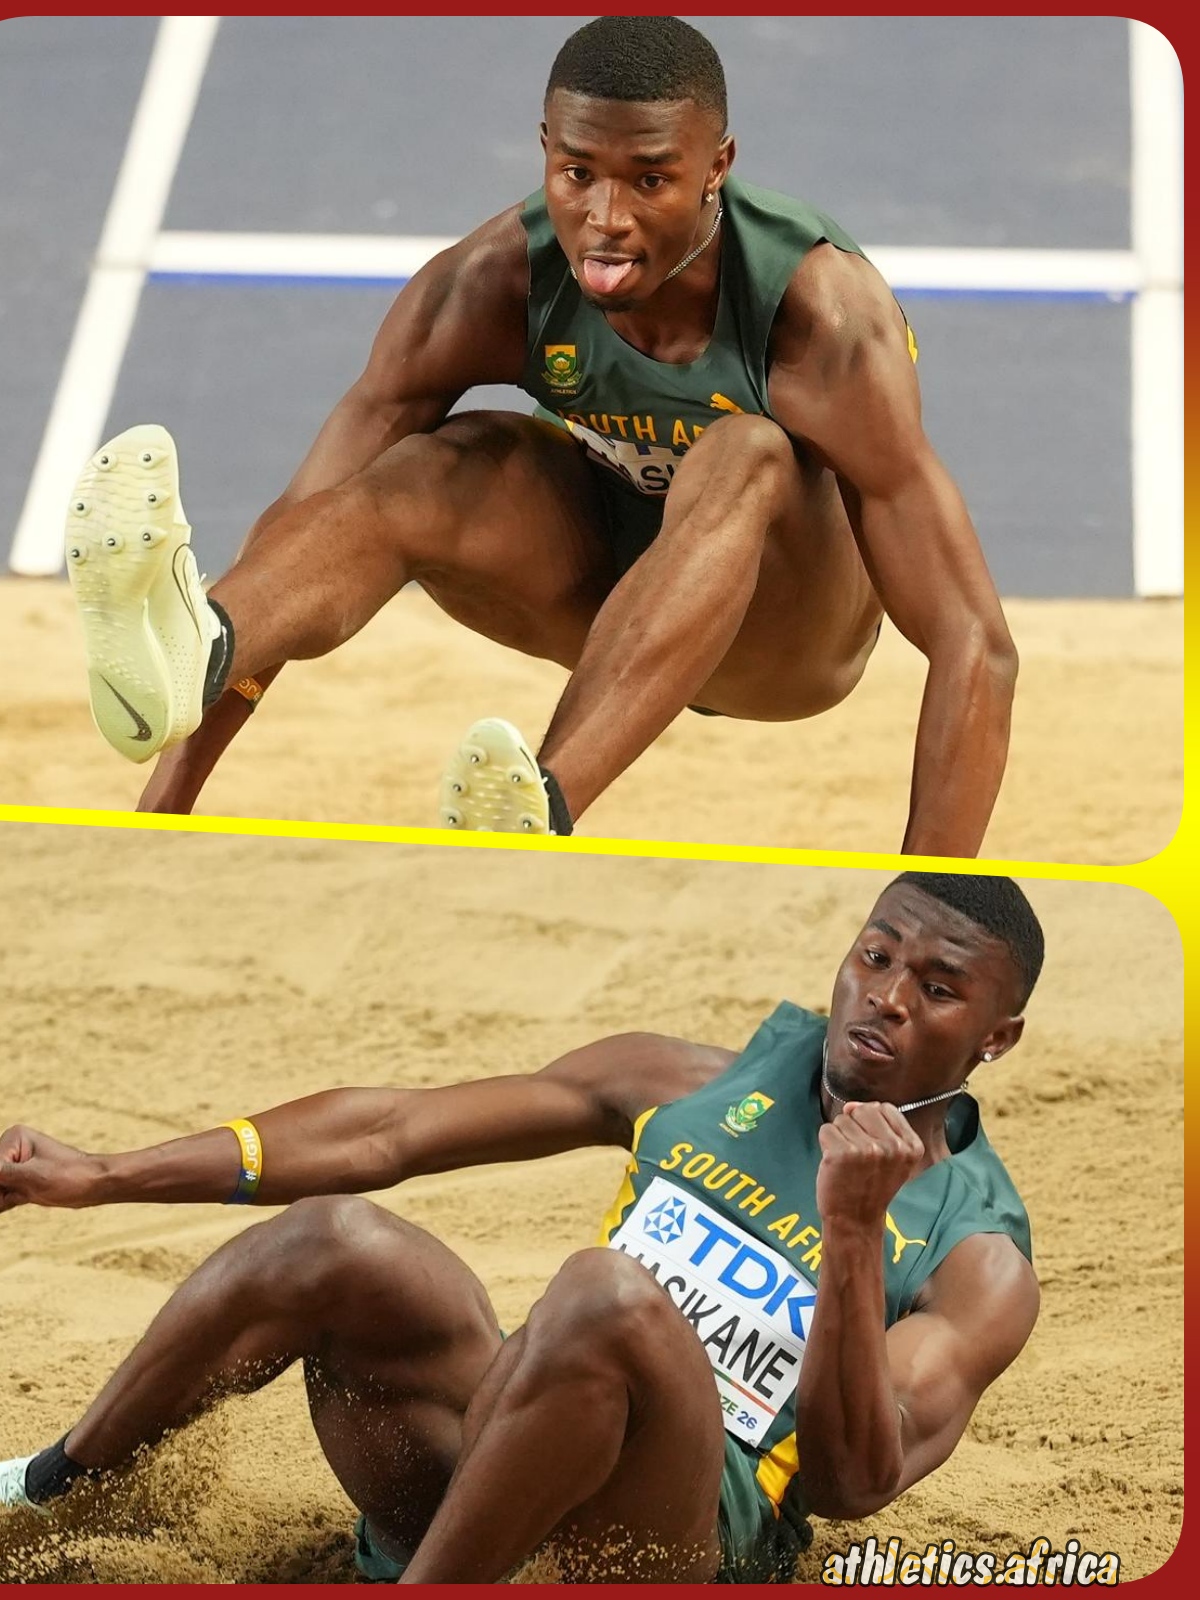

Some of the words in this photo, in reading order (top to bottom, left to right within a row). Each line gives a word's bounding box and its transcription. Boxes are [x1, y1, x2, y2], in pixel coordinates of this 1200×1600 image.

[557, 409, 656, 442] OUTH
[660, 1143, 776, 1217] SOUTH
[767, 1213, 822, 1272] AFR
[689, 1215, 817, 1342] TDK
[737, 1411, 758, 1430] 26
